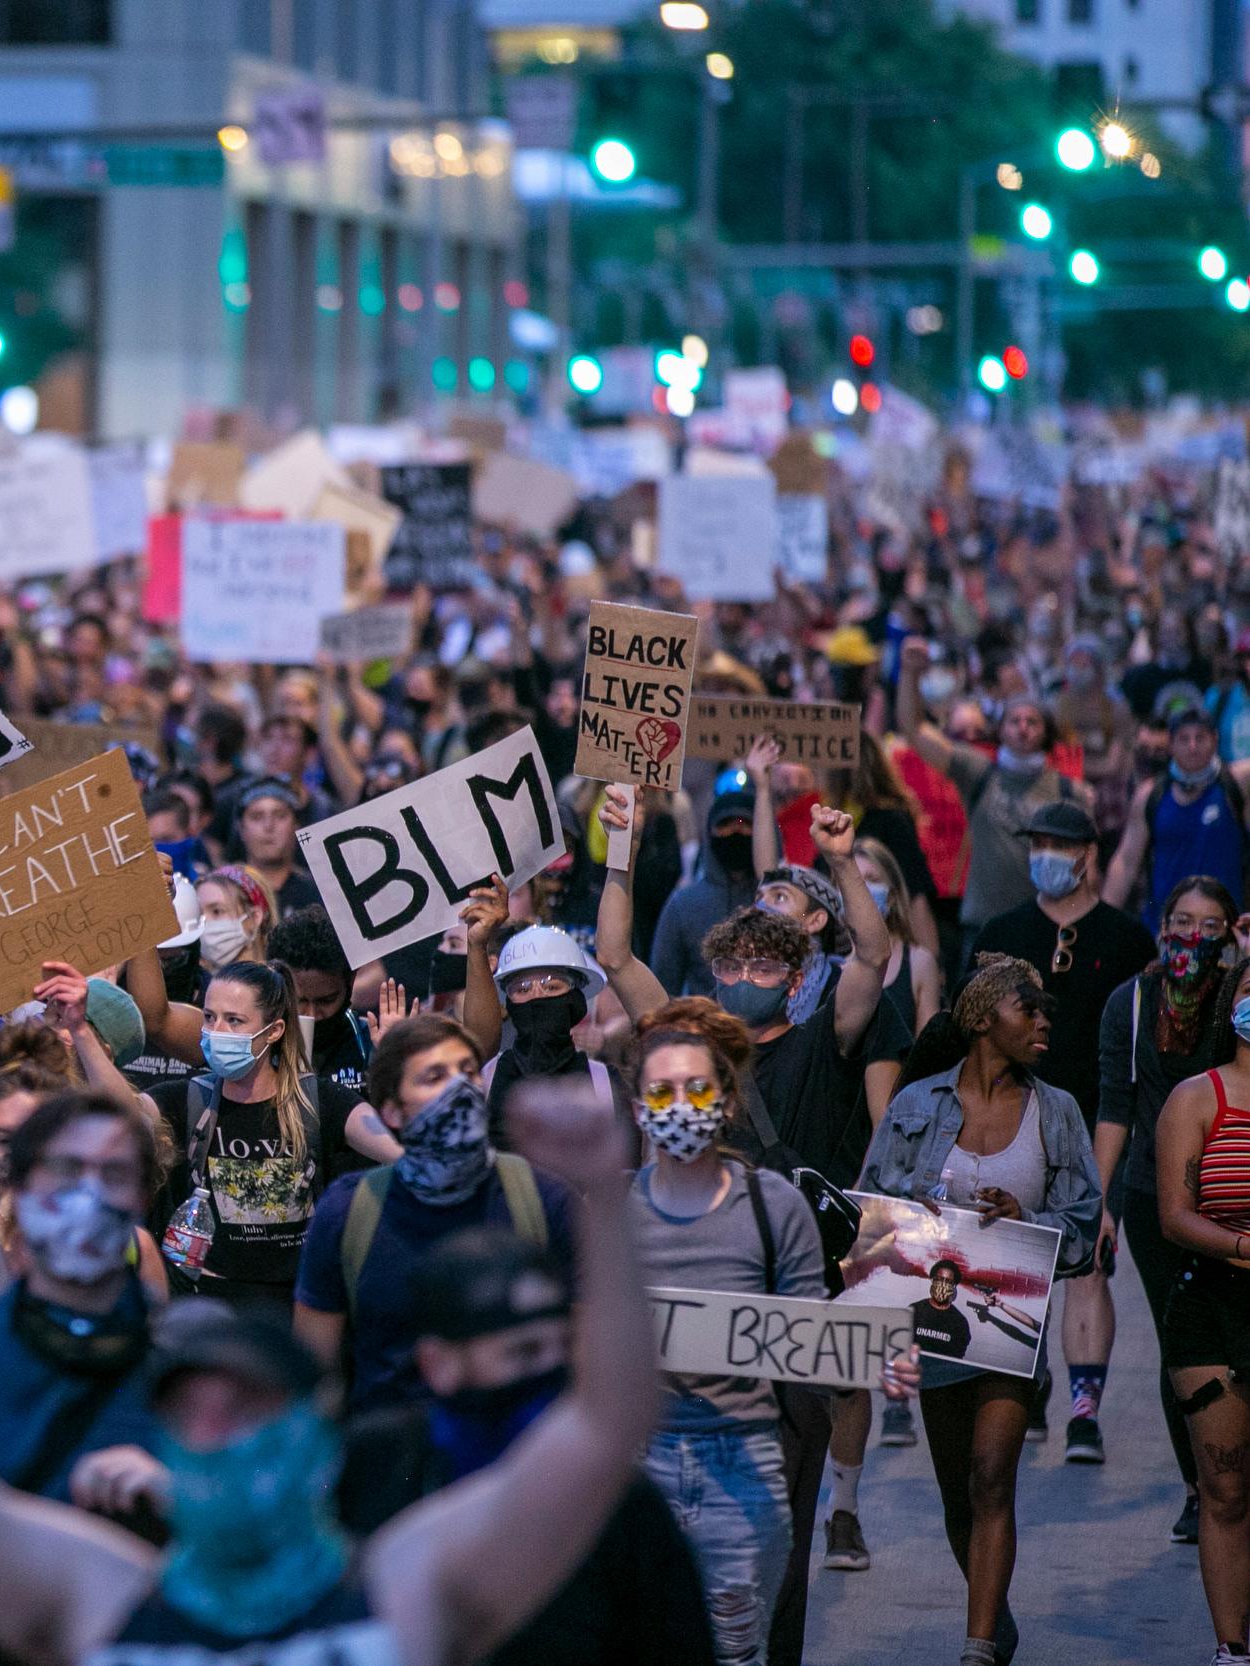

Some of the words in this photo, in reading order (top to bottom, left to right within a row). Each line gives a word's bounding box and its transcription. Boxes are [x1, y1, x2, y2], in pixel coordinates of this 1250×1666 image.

[589, 626, 687, 670] BLACK
[584, 672, 684, 717] LIVES
[582, 709, 671, 787] MATTER!
[734, 735, 853, 759] JSTICE
[0, 895, 99, 965] GEORGE
[62, 914, 144, 966] FLOYD
[505, 942, 537, 965] BLM
[728, 1305, 910, 1380] BREATHE
